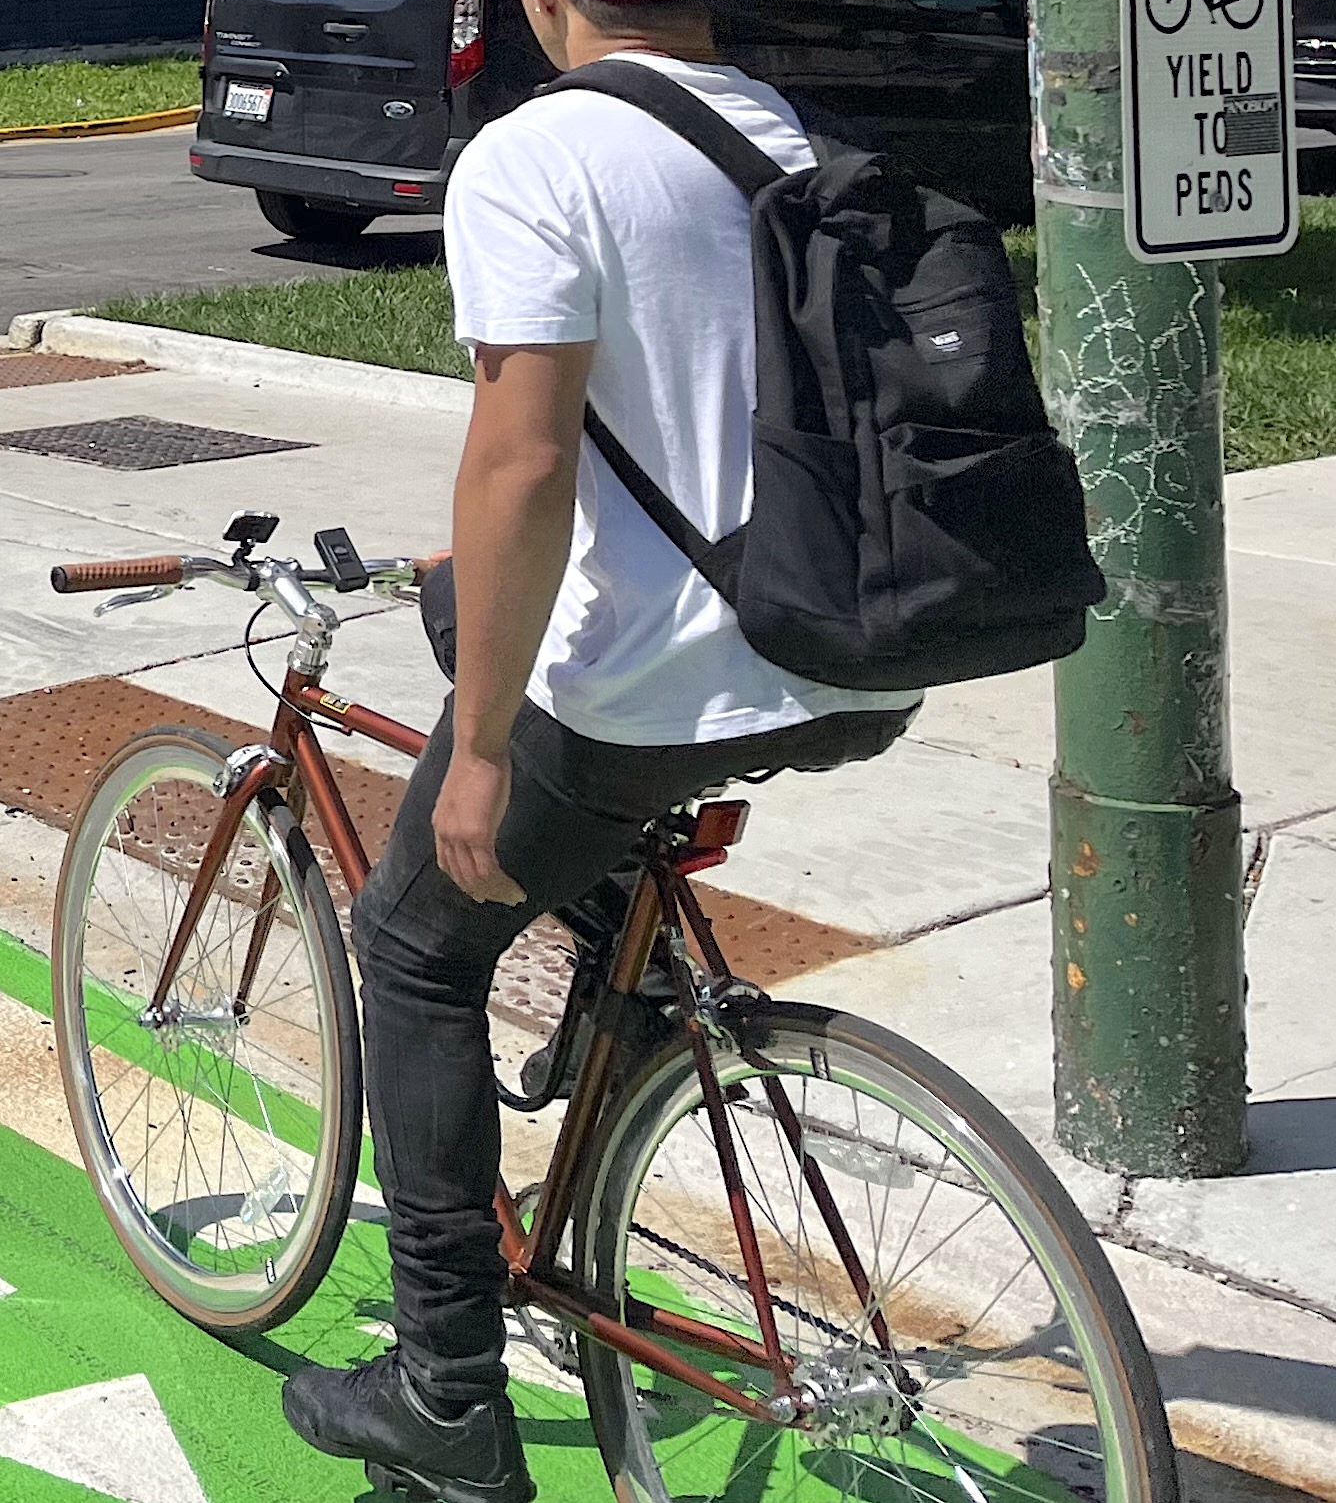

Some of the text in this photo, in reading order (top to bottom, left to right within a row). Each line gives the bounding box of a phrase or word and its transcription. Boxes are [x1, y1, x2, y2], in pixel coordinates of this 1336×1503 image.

[1166, 51, 1252, 98] YIELD
[1194, 111, 1228, 156] TO
[1175, 168, 1253, 217] PEDS
